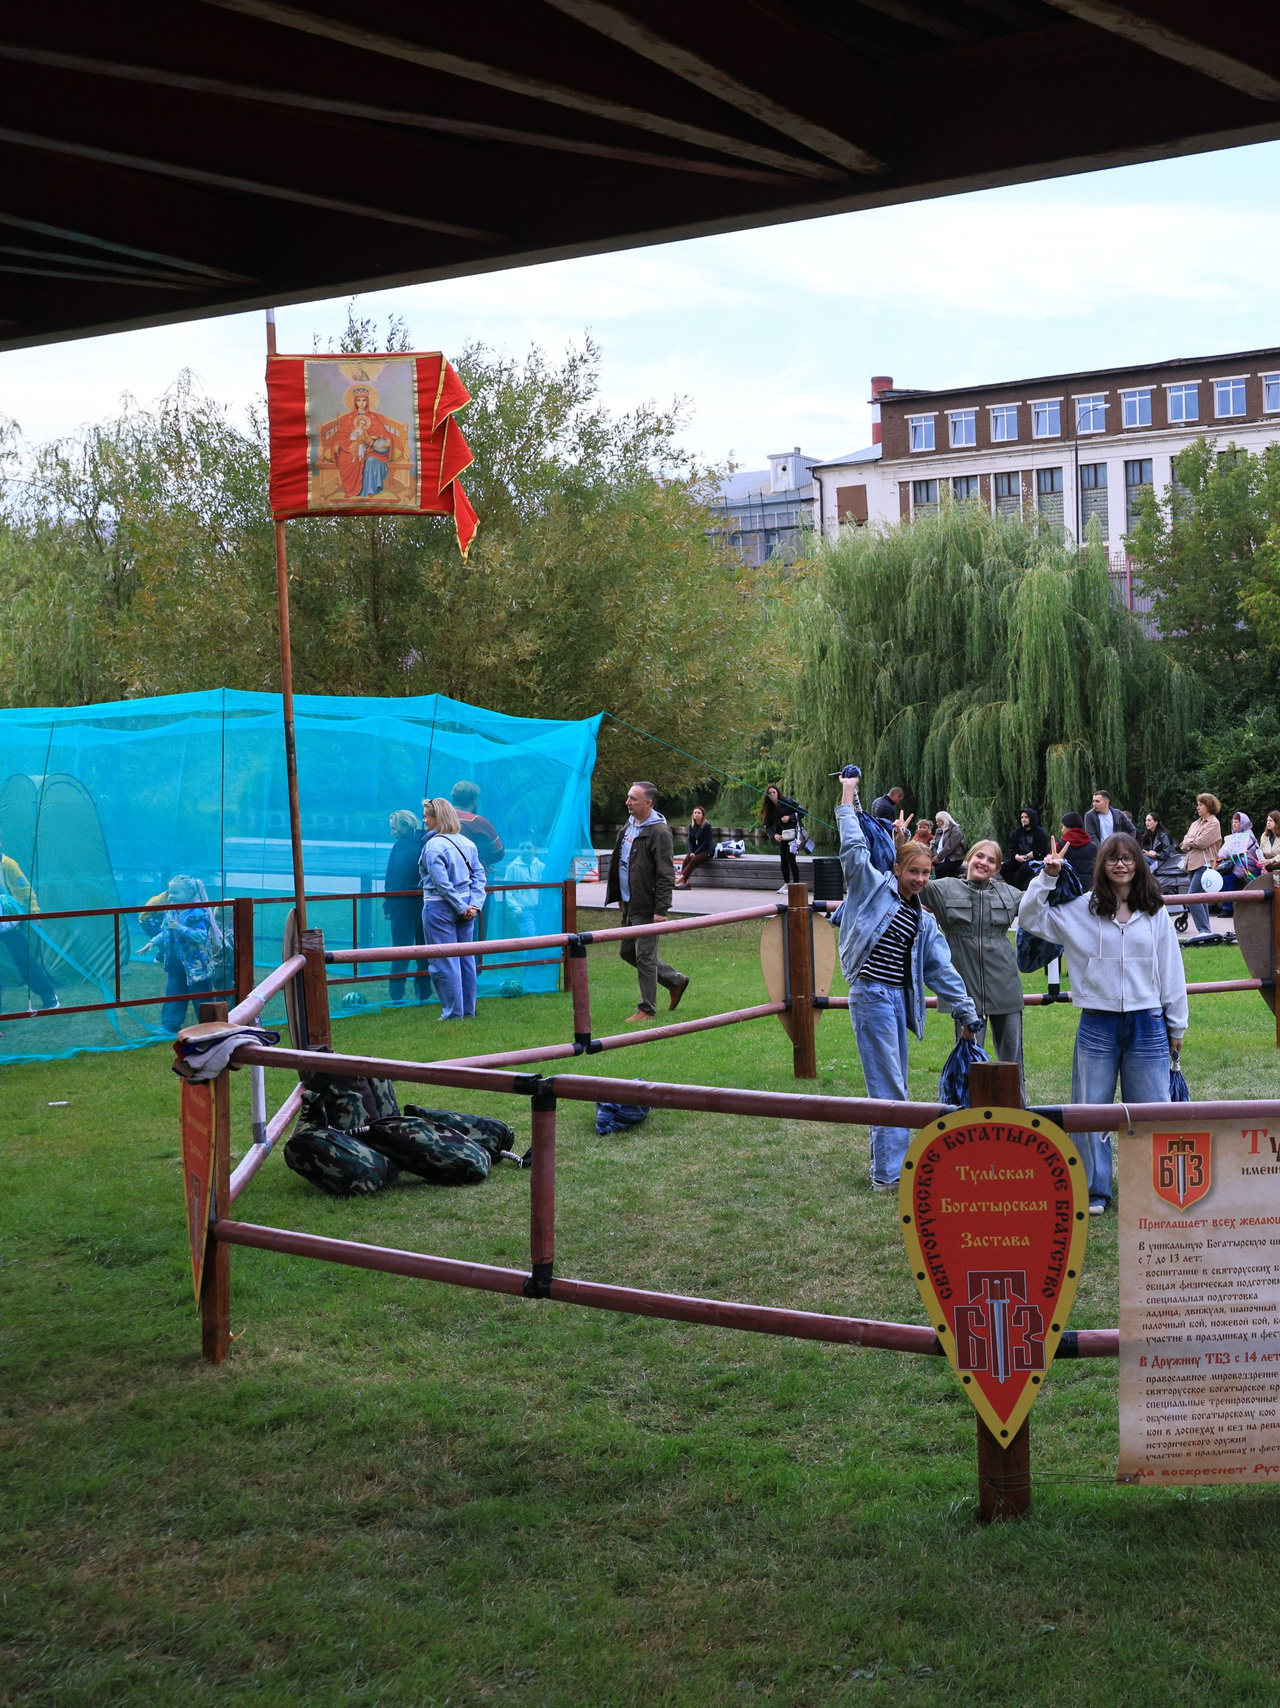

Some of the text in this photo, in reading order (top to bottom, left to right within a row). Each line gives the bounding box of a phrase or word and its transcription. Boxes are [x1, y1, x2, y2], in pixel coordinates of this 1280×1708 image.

[955, 1166, 1034, 1185] Тульская
[917, 1127, 1070, 1300] СВЯТОРУССКОЕ БОГАТЫРСКОЕ БРАТСТВО
[940, 1198, 1048, 1216] Богатырская
[1138, 1218, 1208, 1232] Приглашает
[1212, 1217, 1236, 1229] всех
[961, 1232, 1030, 1248] Застава
[1138, 1241, 1145, 1250] В
[1148, 1241, 1203, 1253] уникальную
[1207, 1239, 1267, 1250] Богатырскую
[1146, 1254, 1152, 1264] 7
[1155, 1256, 1166, 1265] до
[1169, 1254, 1179, 1263] 13
[1182, 1255, 1203, 1263] лет:
[1146, 1267, 1199, 1277] воспитание
[1211, 1265, 1271, 1276] святорусских
[1146, 1282, 1176, 1291] общая
[1179, 1280, 1233, 1291] физическая
[1146, 1293, 1258, 1305] специальная подготовка
[1184, 1307, 1227, 1317] движуля,
[1230, 1304, 1277, 1313] шапочный
[1142, 1320, 1186, 1330] палочный
[1189, 1319, 1207, 1328] бой,
[1210, 1317, 1249, 1327] ножевой
[1252, 1316, 1270, 1326] бой,
[1146, 1334, 1183, 1346] участие
[1195, 1332, 1248, 1343] праздниках
[1139, 1356, 1147, 1367] В
[1151, 1355, 1201, 1369] Дружину
[1205, 1352, 1231, 1365] ТБЗ
[1234, 1355, 1240, 1363] с
[1244, 1351, 1257, 1362] 14
[1146, 1374, 1207, 1384] православное
[1210, 1371, 1279, 1382] мировоззрение
[1146, 1385, 1206, 1397] святорусское
[1209, 1384, 1266, 1394] богатырское
[1146, 1400, 1206, 1409] специальные
[1209, 1395, 1278, 1407] тренировочные
[1146, 1408, 1276, 1424] обучение богатырскому бою
[1146, 1429, 1162, 1437] бои
[1174, 1426, 1215, 1436] доспехах
[1227, 1424, 1243, 1432] без
[1146, 1437, 1247, 1450] исторического оружия
[1146, 1452, 1183, 1461] участие
[1195, 1447, 1247, 1457] праздниках
[1133, 1467, 1155, 1478] Да
[1161, 1466, 1247, 1477] воскреснет
